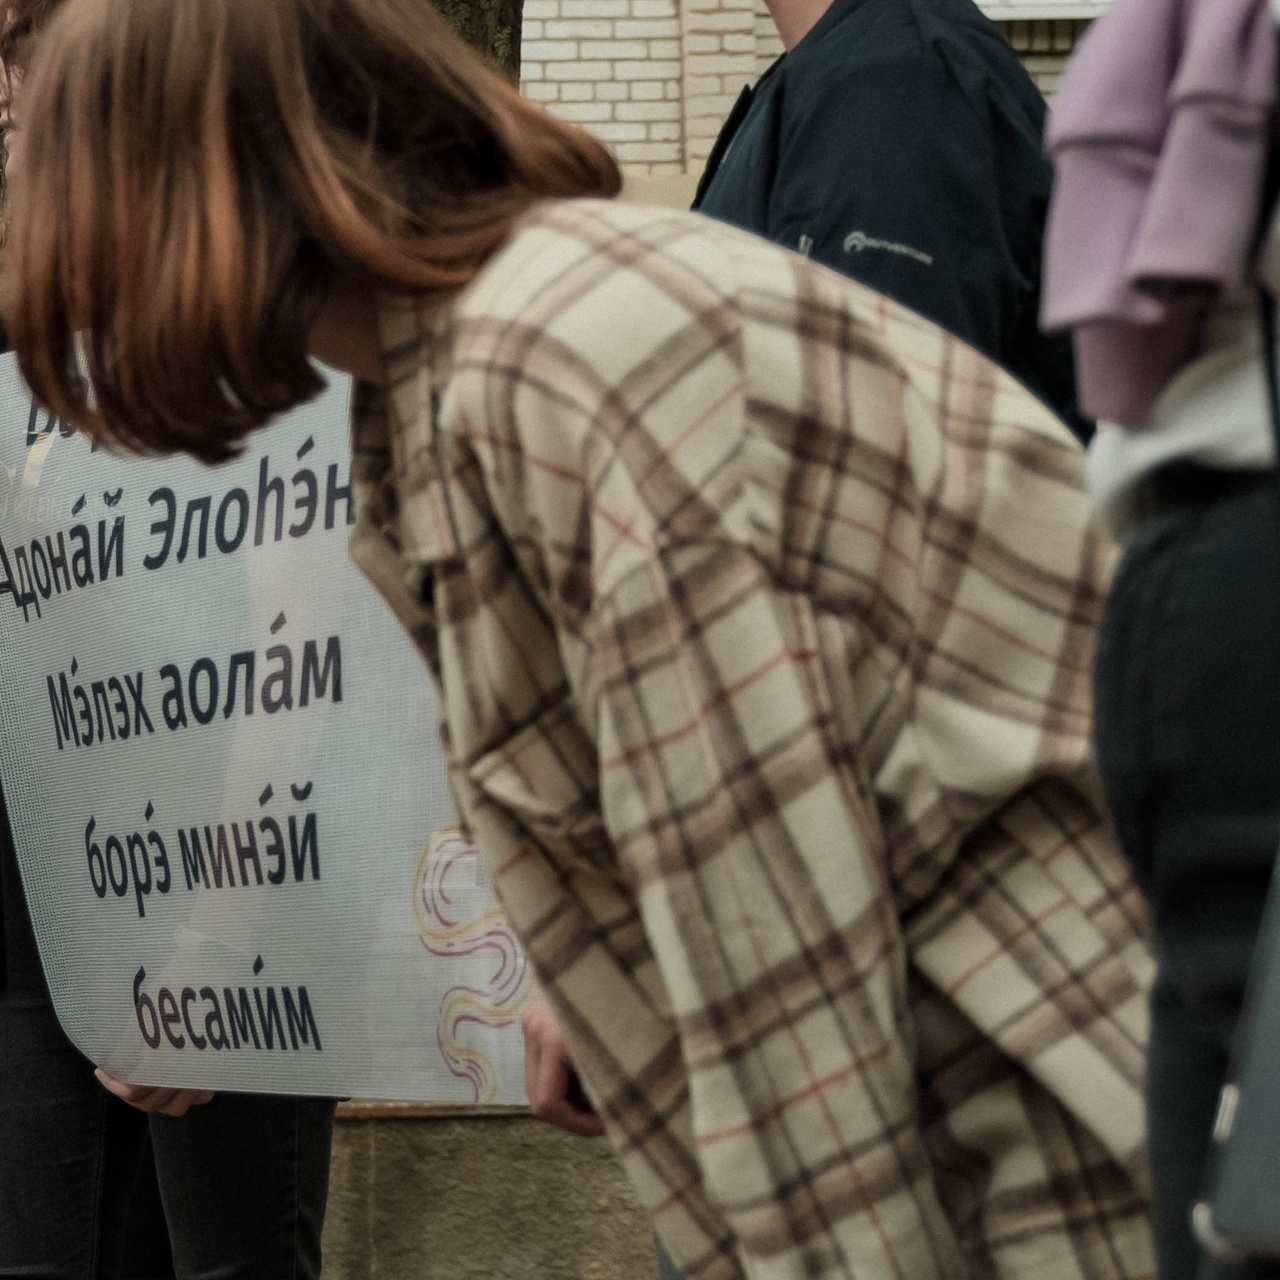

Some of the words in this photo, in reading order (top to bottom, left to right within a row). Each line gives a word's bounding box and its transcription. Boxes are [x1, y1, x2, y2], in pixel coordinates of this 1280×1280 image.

[46, 655, 156, 750] Мэ́лэх
[158, 610, 343, 731] аола́м
[85, 799, 171, 918] борэ́
[177, 780, 321, 891] минэ́й
[132, 953, 323, 1051] бесами́м
